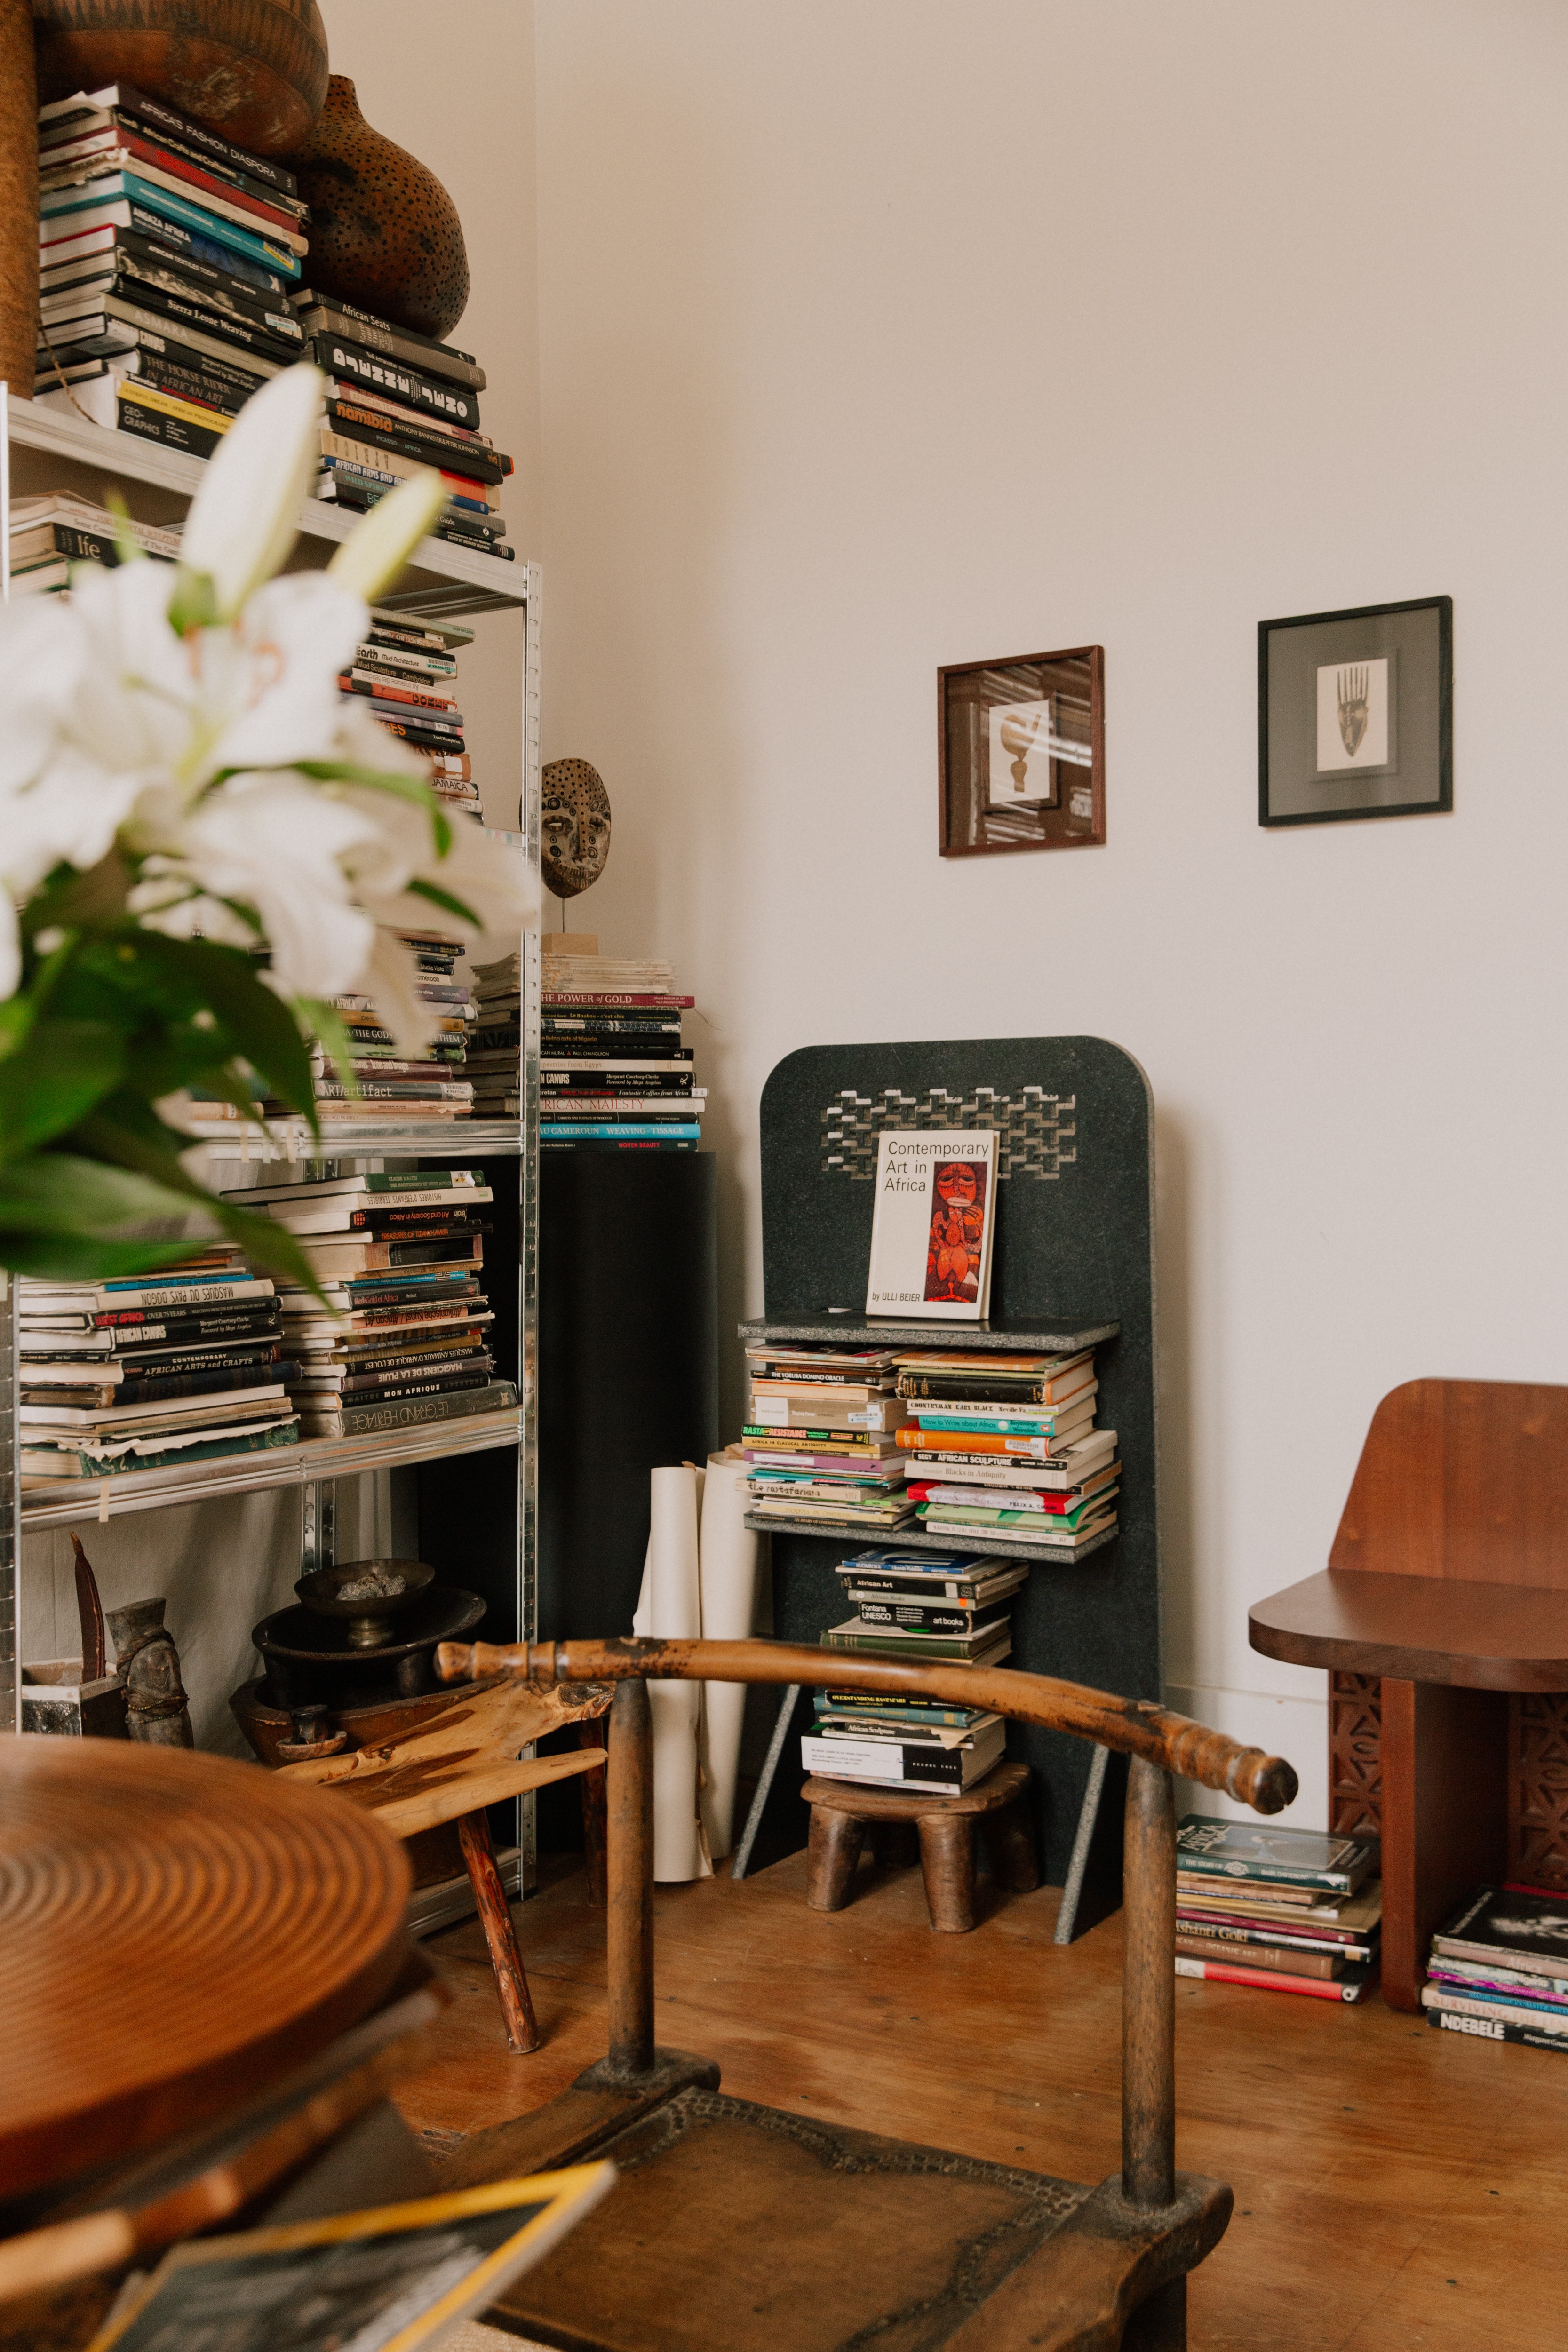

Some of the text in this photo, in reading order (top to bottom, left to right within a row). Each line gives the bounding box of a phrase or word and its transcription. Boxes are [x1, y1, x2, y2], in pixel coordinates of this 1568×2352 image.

[186, 125, 276, 179] FASHION DIASPORA
[167, 299, 252, 342] Sierra Leone Weaving
[342, 304, 390, 331] African Seats
[135, 311, 187, 339] ASMARA
[144, 356, 231, 395] THE HORSE RIDER
[162, 376, 224, 404] AFRICAN ART
[353, 393, 381, 408] AFRICAN
[336, 405, 393, 433] namibia
[376, 435, 422, 453] PICASSO AFRICA
[457, 444, 479, 455] JOHNSON
[336, 459, 392, 484] AFRICAN ARMS AND
[345, 475, 363, 485] WILD
[440, 516, 455, 525] Guide
[393, 657, 419, 667] Architecture
[358, 660, 430, 686] Mud Cambridge
[432, 778, 468, 792] JAMAICA
[337, 999, 357, 1010] AFRICA
[605, 995, 632, 1004] GOLD
[354, 1029, 460, 1043] THE THEM
[370, 1059, 409, 1072] Icon Image
[546, 1073, 570, 1084] CANVAS
[590, 1099, 645, 1111] MAJESTY
[888, 1141, 989, 1158] Contemporary
[885, 1160, 927, 1174] Art in
[884, 1178, 926, 1191] Africa
[367, 1195, 391, 1205] TERRIBLES
[142, 1286, 233, 1305] MASQUES DU PAYS DOGON
[872, 1292, 920, 1303] by ULLI BEIER
[365, 1318, 374, 1327] Art
[116, 1325, 167, 1343] AFRICAN CANVAS
[172, 1353, 227, 1363] CONTEMPORARY
[424, 1351, 448, 1360] ANIMAUX
[450, 1348, 473, 1357] MASQUES
[145, 1365, 182, 1375] AFRICAN
[184, 1362, 206, 1371] ARTS
[223, 1358, 253, 1367] CRAFTS
[424, 1363, 462, 1375] MAGICIENS
[378, 1373, 398, 1382] PLUIE
[406, 1384, 440, 1394] AFRIQUE
[770, 1428, 807, 1438] RESISTANCE
[969, 1457, 1012, 1466] SCULPTURE
[976, 1470, 1007, 1479] Antiquity
[862, 1612, 891, 1621] UNESCO
[1218, 1926, 1248, 1941] Gold
[1433, 1997, 1507, 2018] SURVIVING
[1441, 2012, 1505, 2040] NDEBELE
